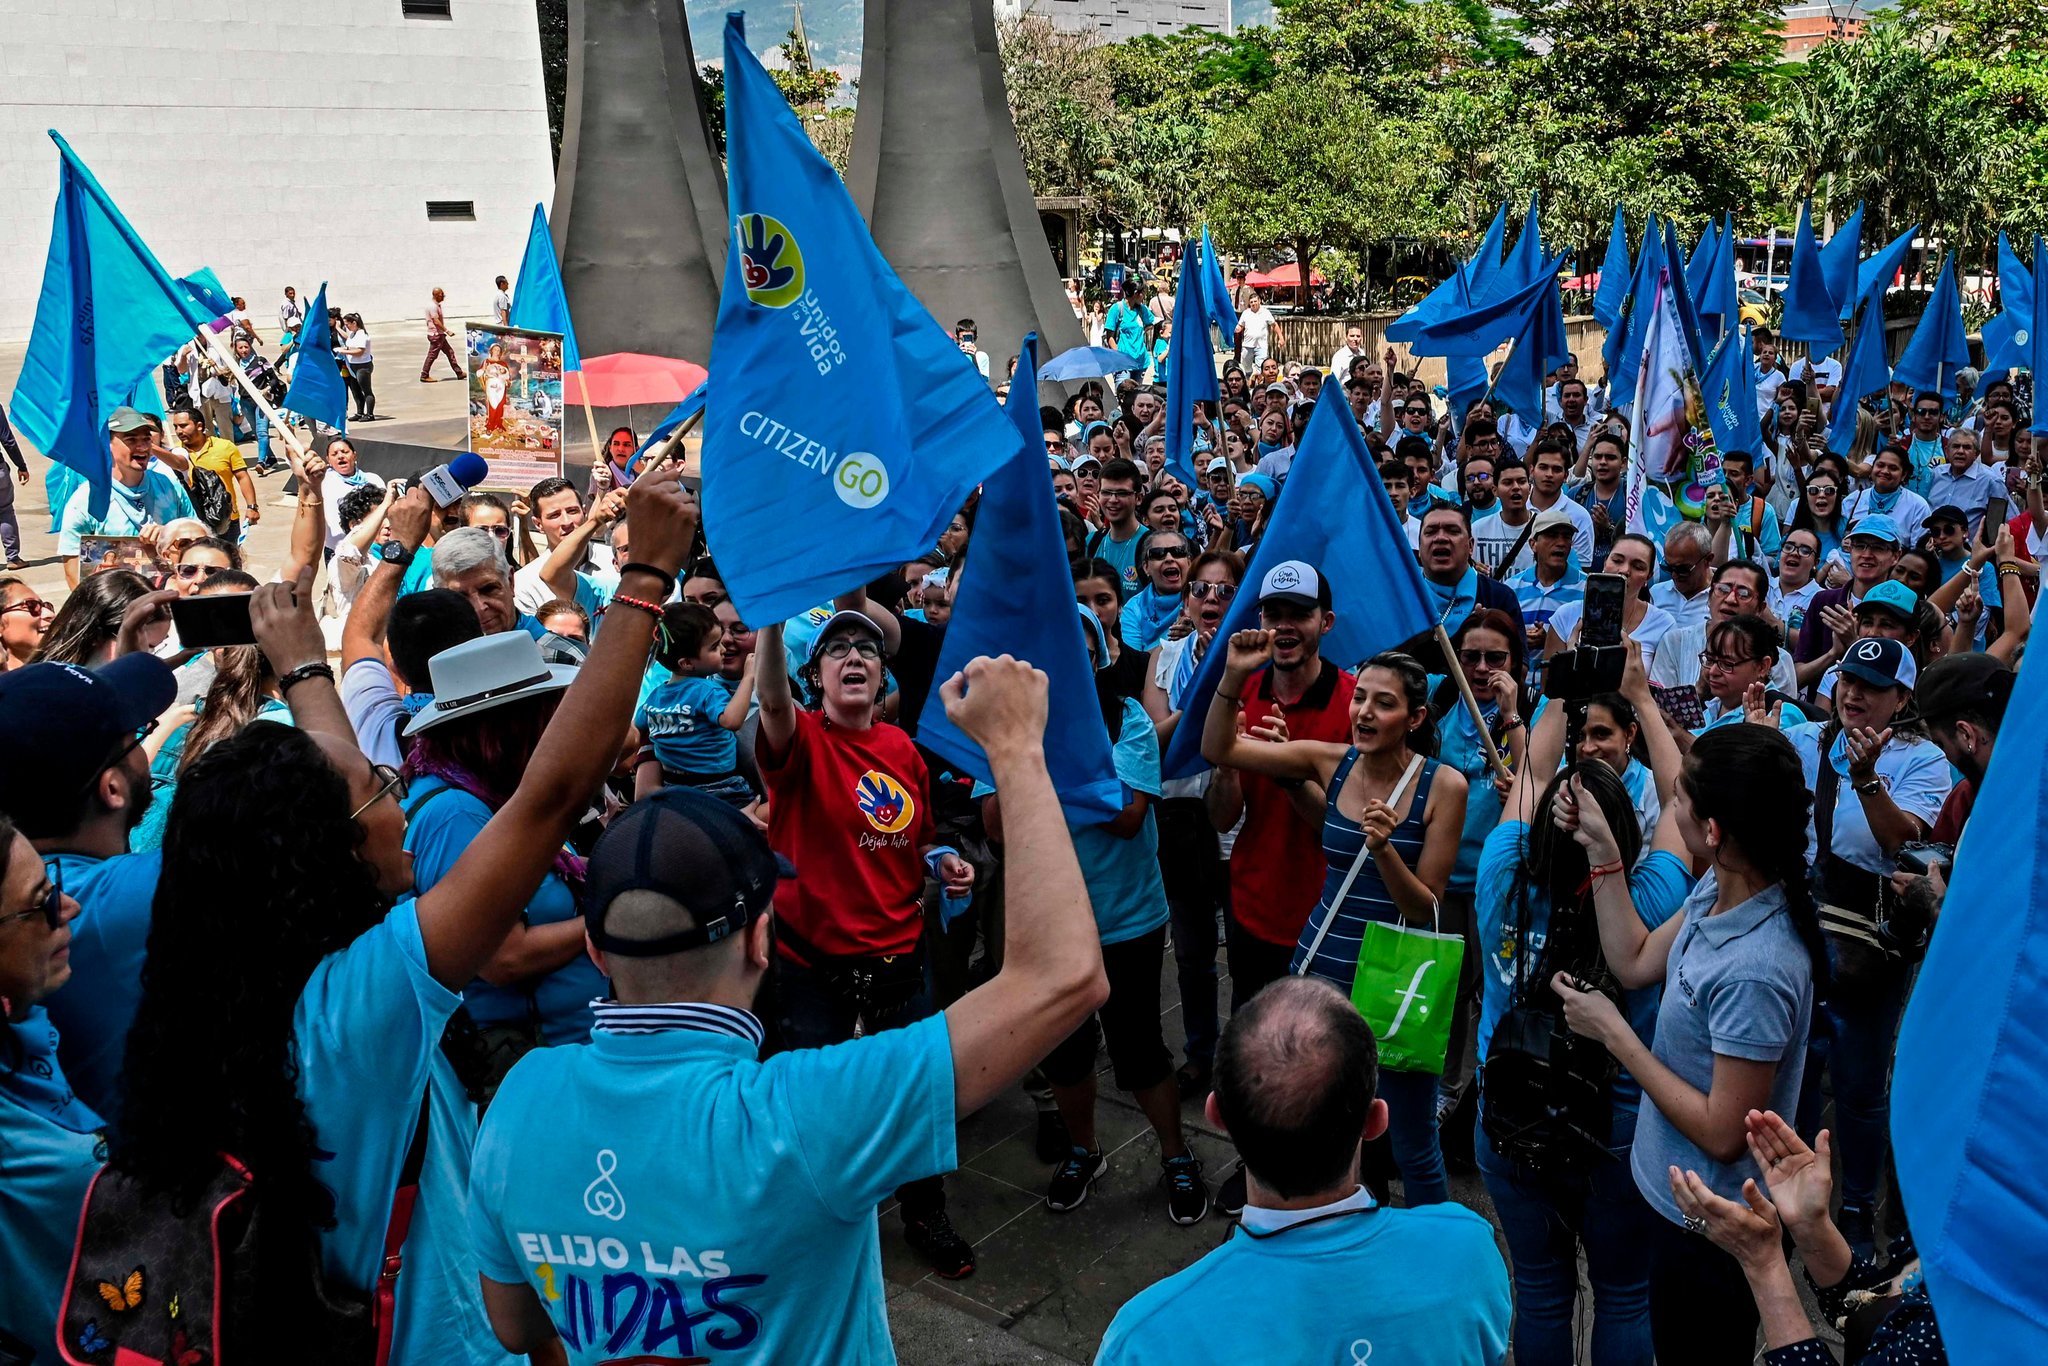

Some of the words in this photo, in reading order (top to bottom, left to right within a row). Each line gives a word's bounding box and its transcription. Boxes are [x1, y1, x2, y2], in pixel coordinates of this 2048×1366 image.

[792, 310, 800, 320] la
[797, 300, 810, 316] por
[805, 288, 846, 365] Unidos
[800, 315, 832, 376] Vida
[739, 411, 837, 475] CITIZEN
[838, 460, 883, 498] GO
[517, 1232, 629, 1269] ELIJO
[640, 1241, 732, 1279] LAS
